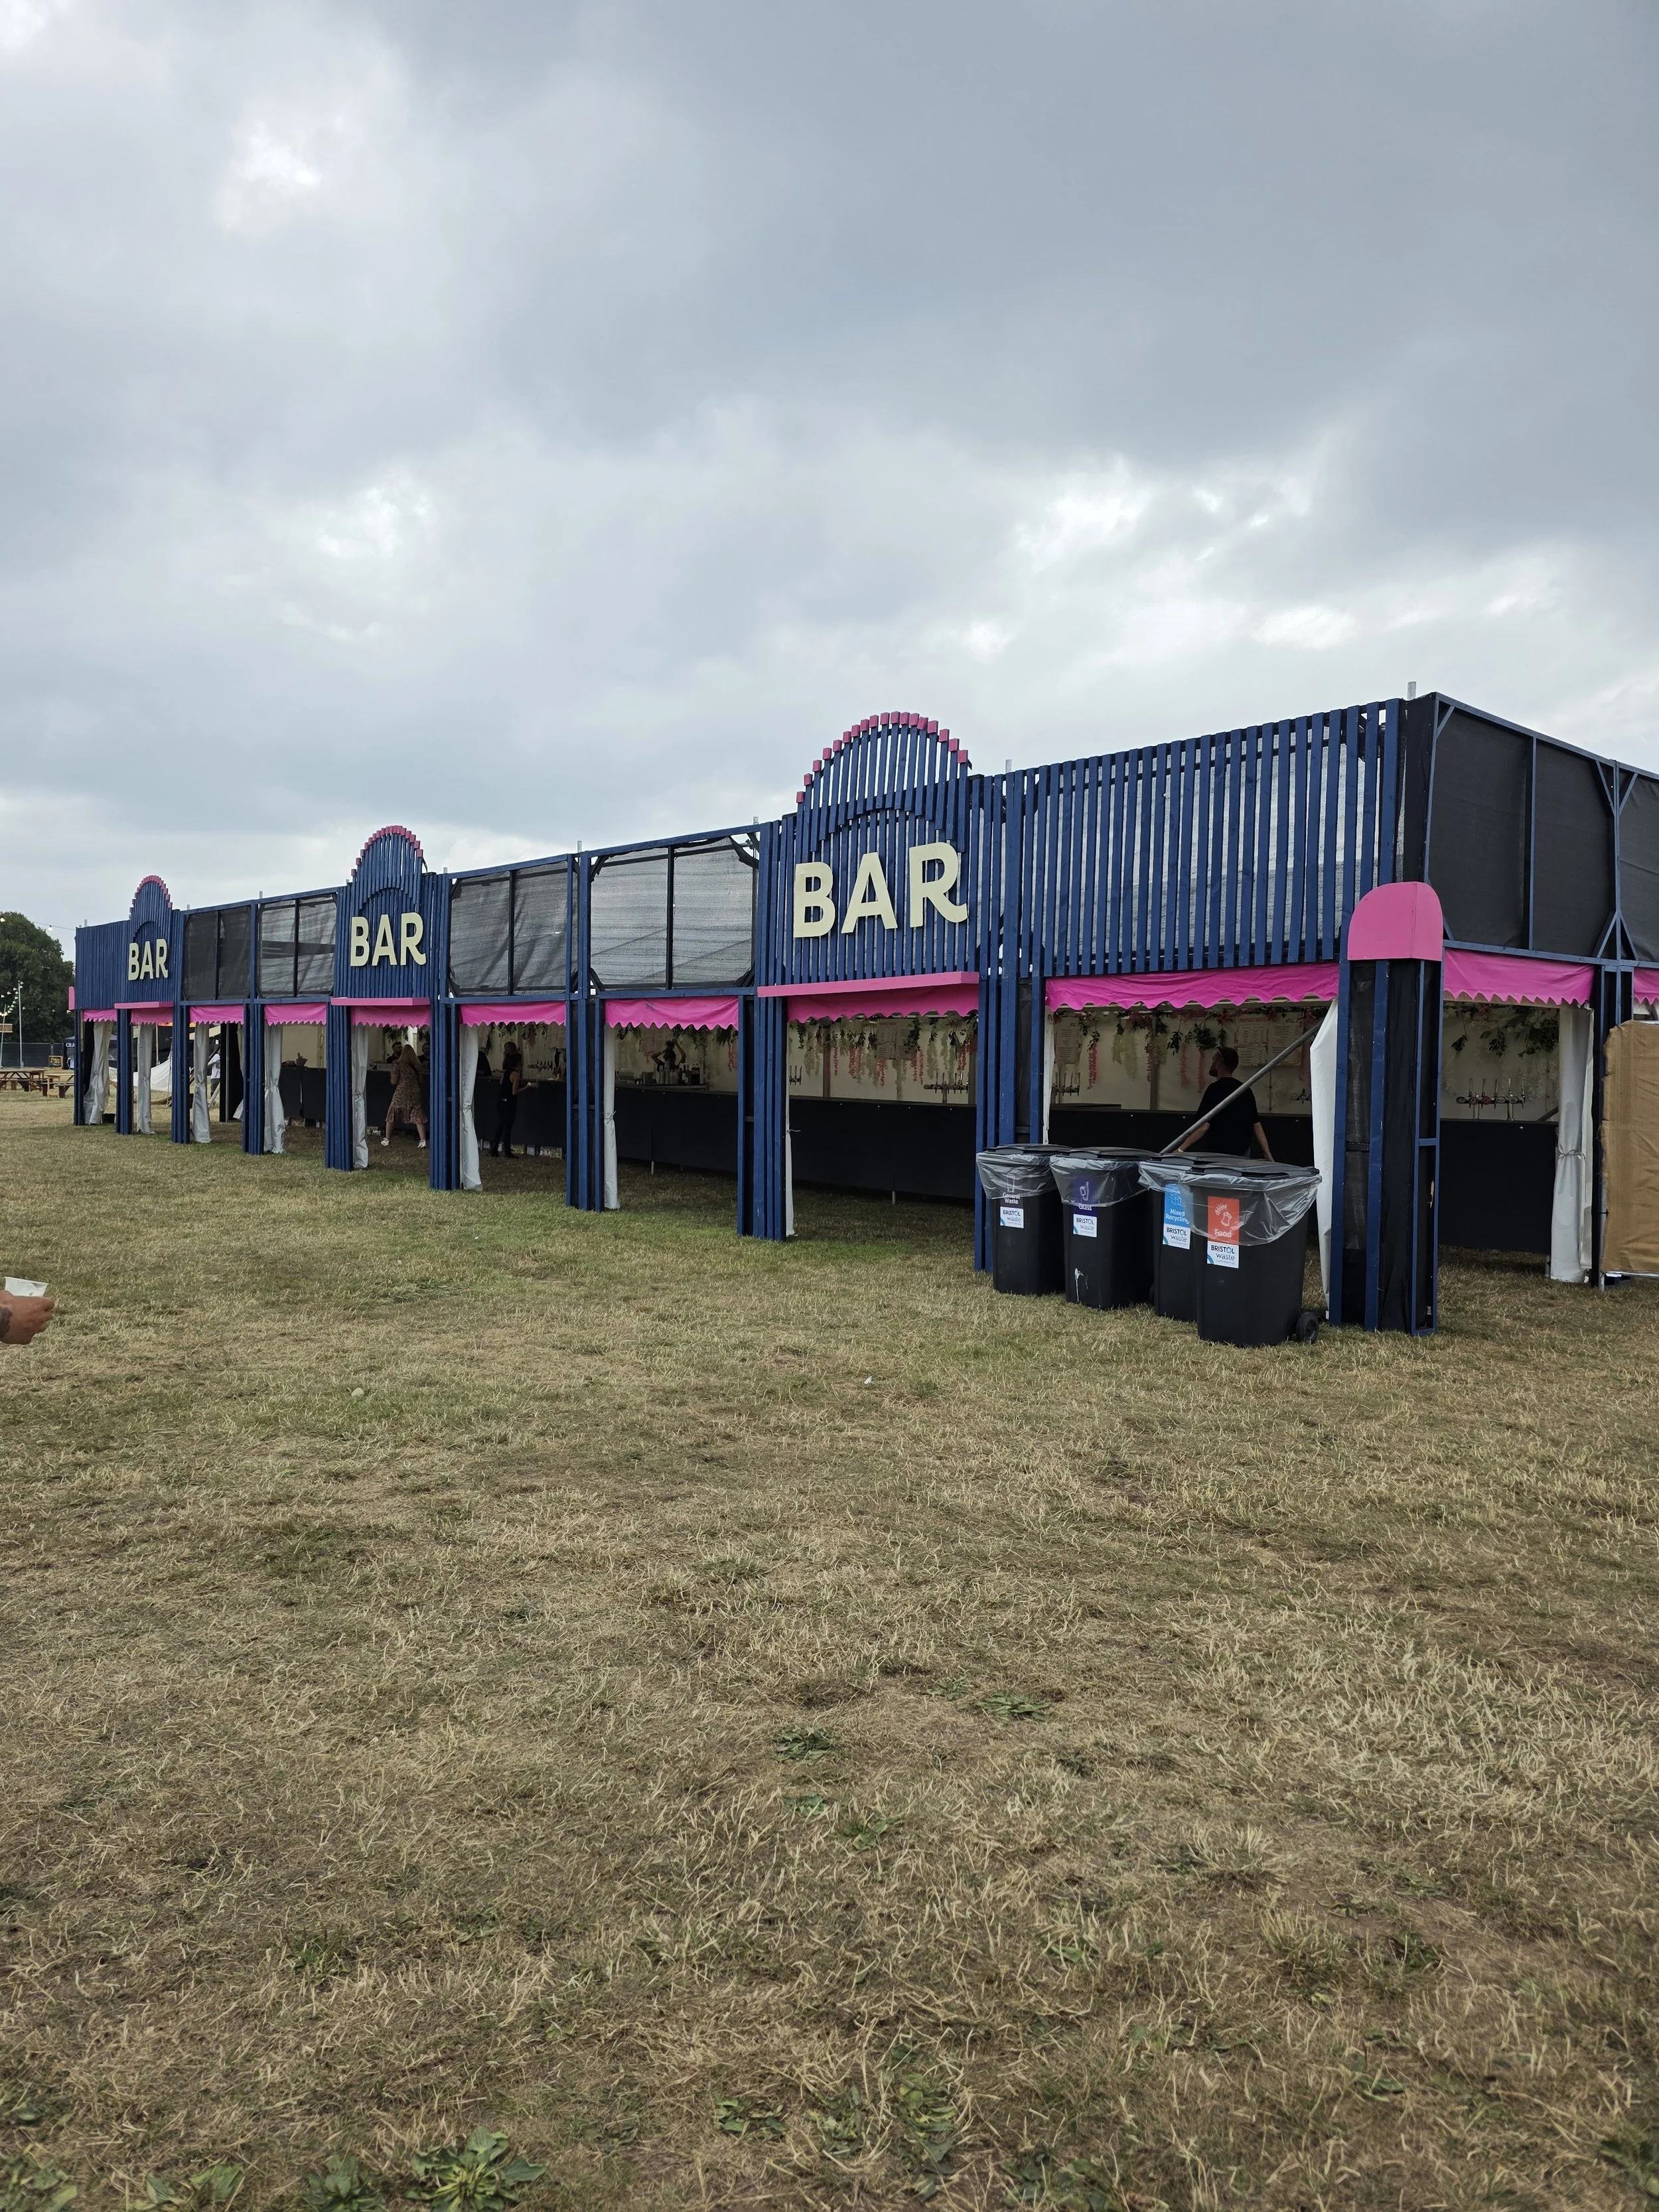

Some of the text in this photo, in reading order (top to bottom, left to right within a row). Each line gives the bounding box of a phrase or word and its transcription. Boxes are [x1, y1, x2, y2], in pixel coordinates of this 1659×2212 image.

[793, 842, 968, 938] BAR
[350, 912, 426, 967] BAR
[128, 938, 168, 980] BAR
[1166, 1227, 1187, 1236] BRISTOL
[1214, 1228, 1232, 1238] Food
[1211, 1244, 1235, 1254] BRISTOL
